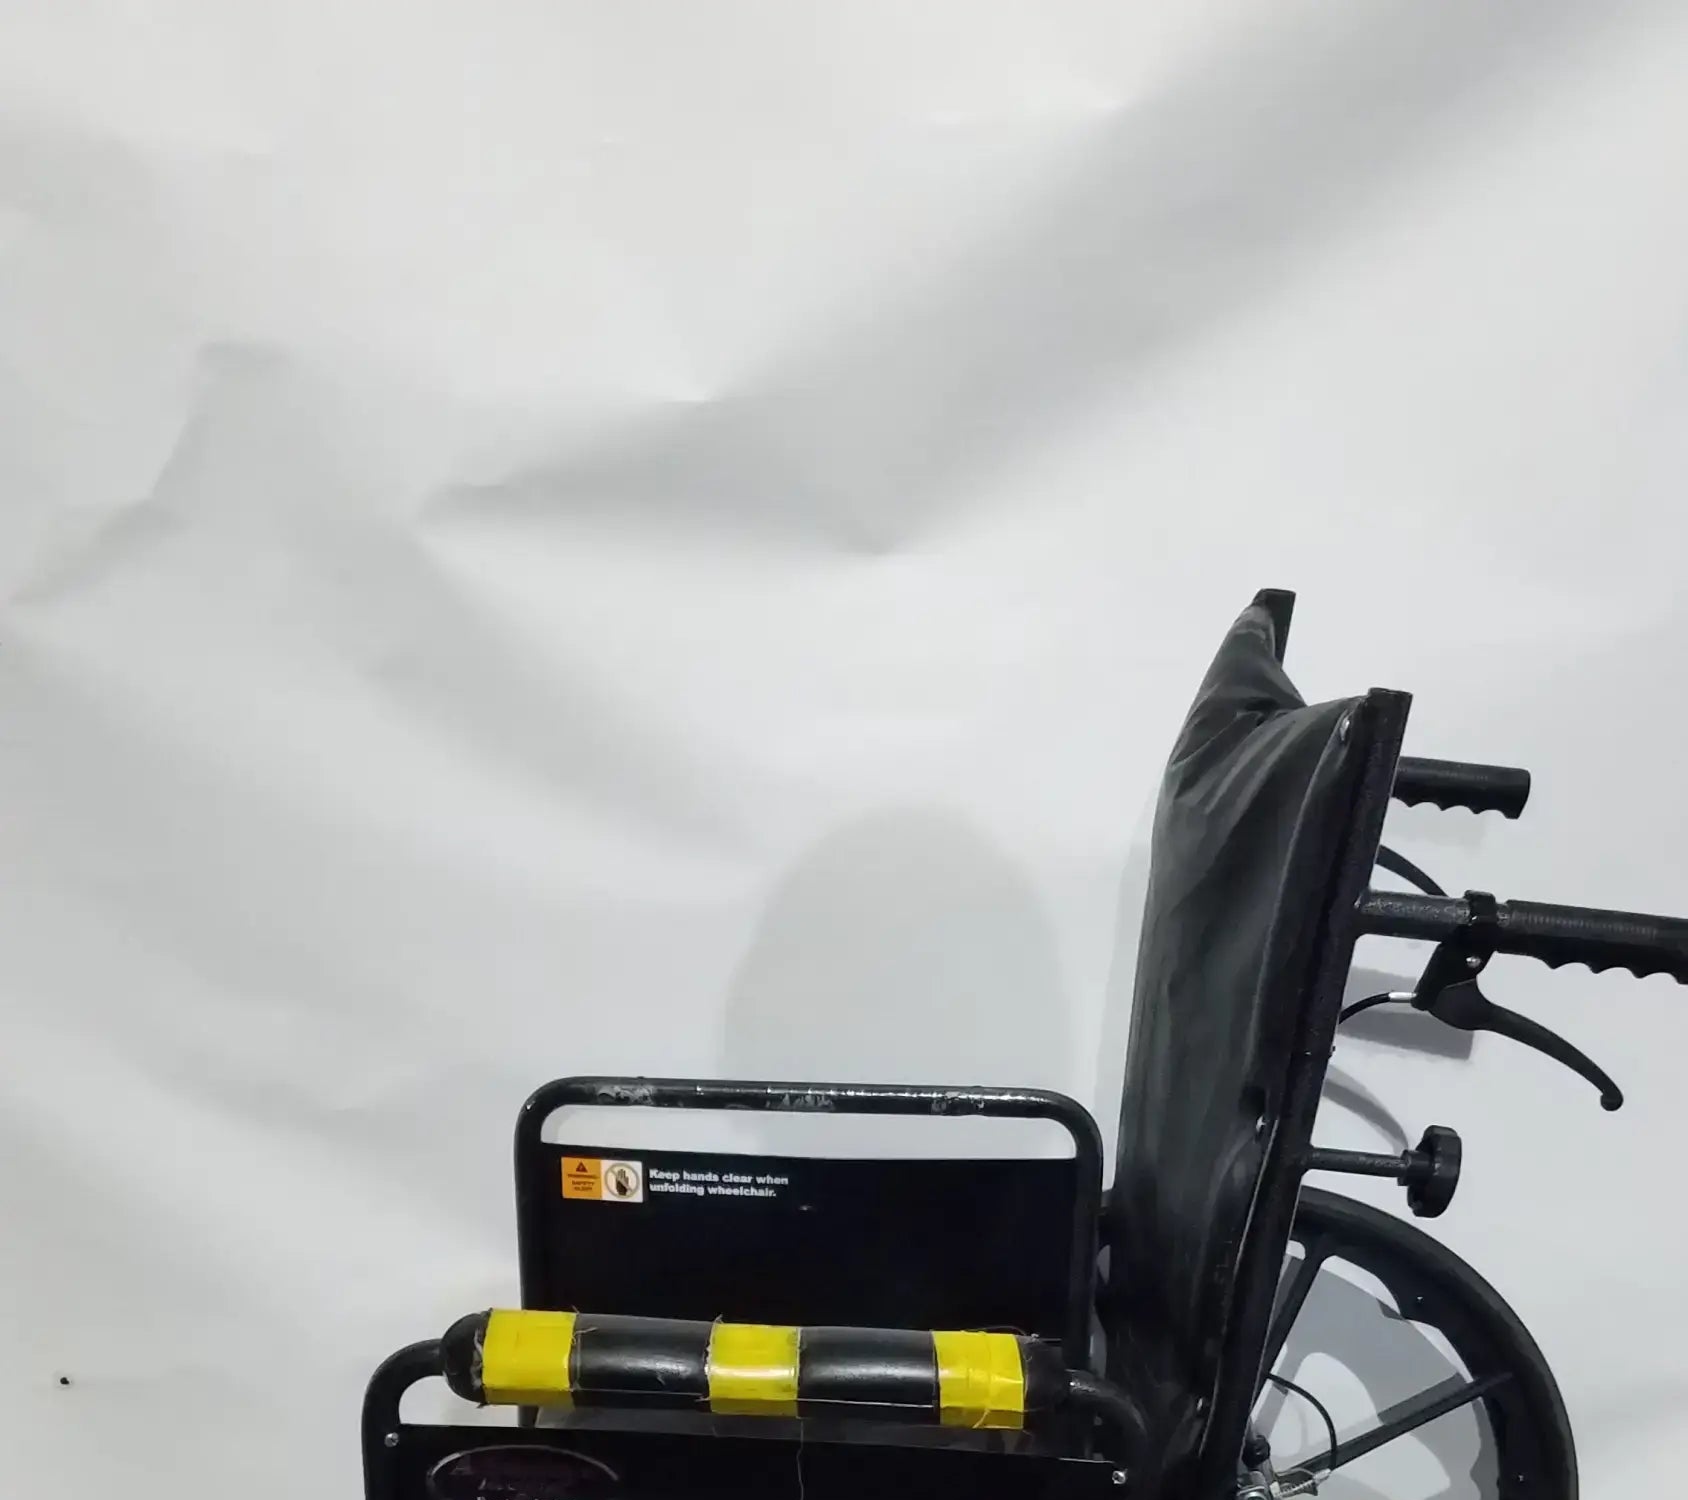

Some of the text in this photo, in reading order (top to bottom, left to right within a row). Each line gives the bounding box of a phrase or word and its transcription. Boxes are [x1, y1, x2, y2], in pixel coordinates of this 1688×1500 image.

[649, 1168, 789, 1185] Keep hands clear when
[649, 1182, 776, 1197] unfolding wheelchair.
